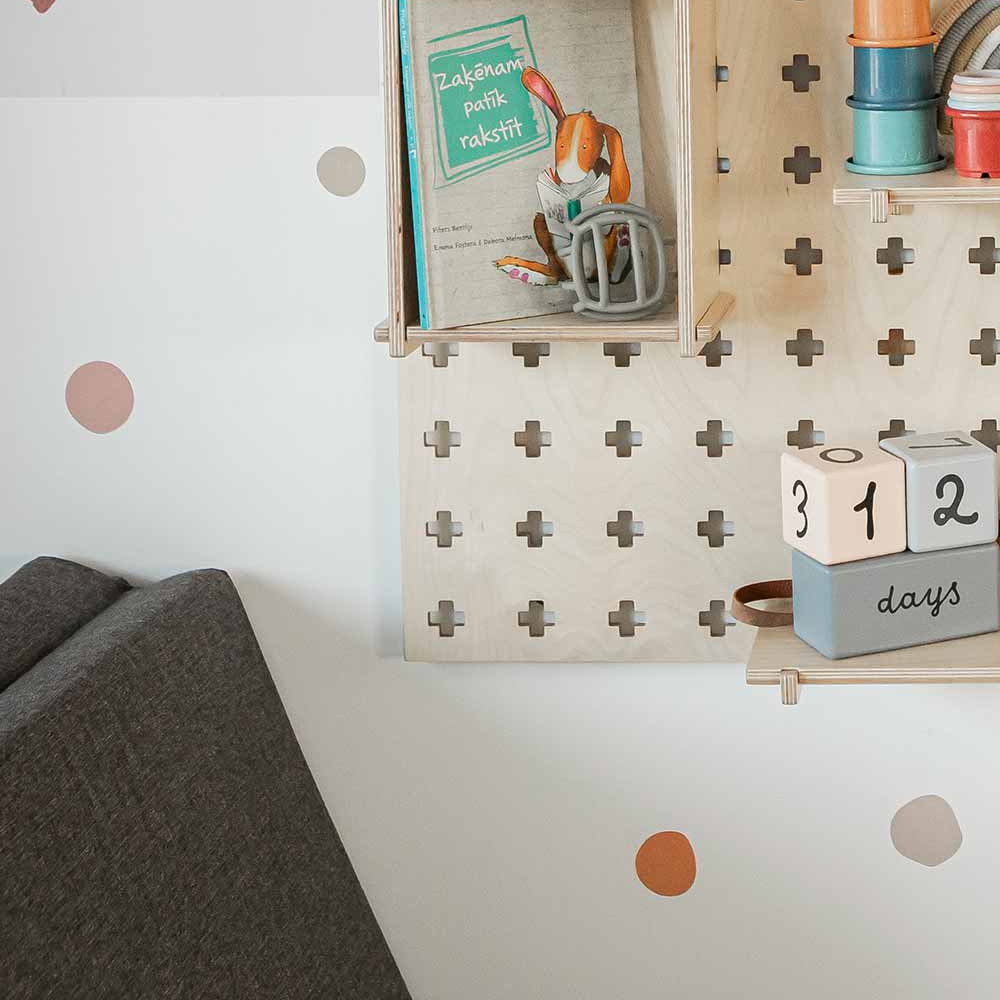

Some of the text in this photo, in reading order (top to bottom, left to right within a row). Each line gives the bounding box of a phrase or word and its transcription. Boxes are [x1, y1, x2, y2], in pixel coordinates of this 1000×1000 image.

[434, 58, 523, 92] Zaķēnam
[464, 88, 508, 119] patīk
[459, 117, 523, 149] rakstīt
[792, 479, 808, 538] 3
[853, 474, 979, 540] 1 2
[877, 581, 961, 617] days
